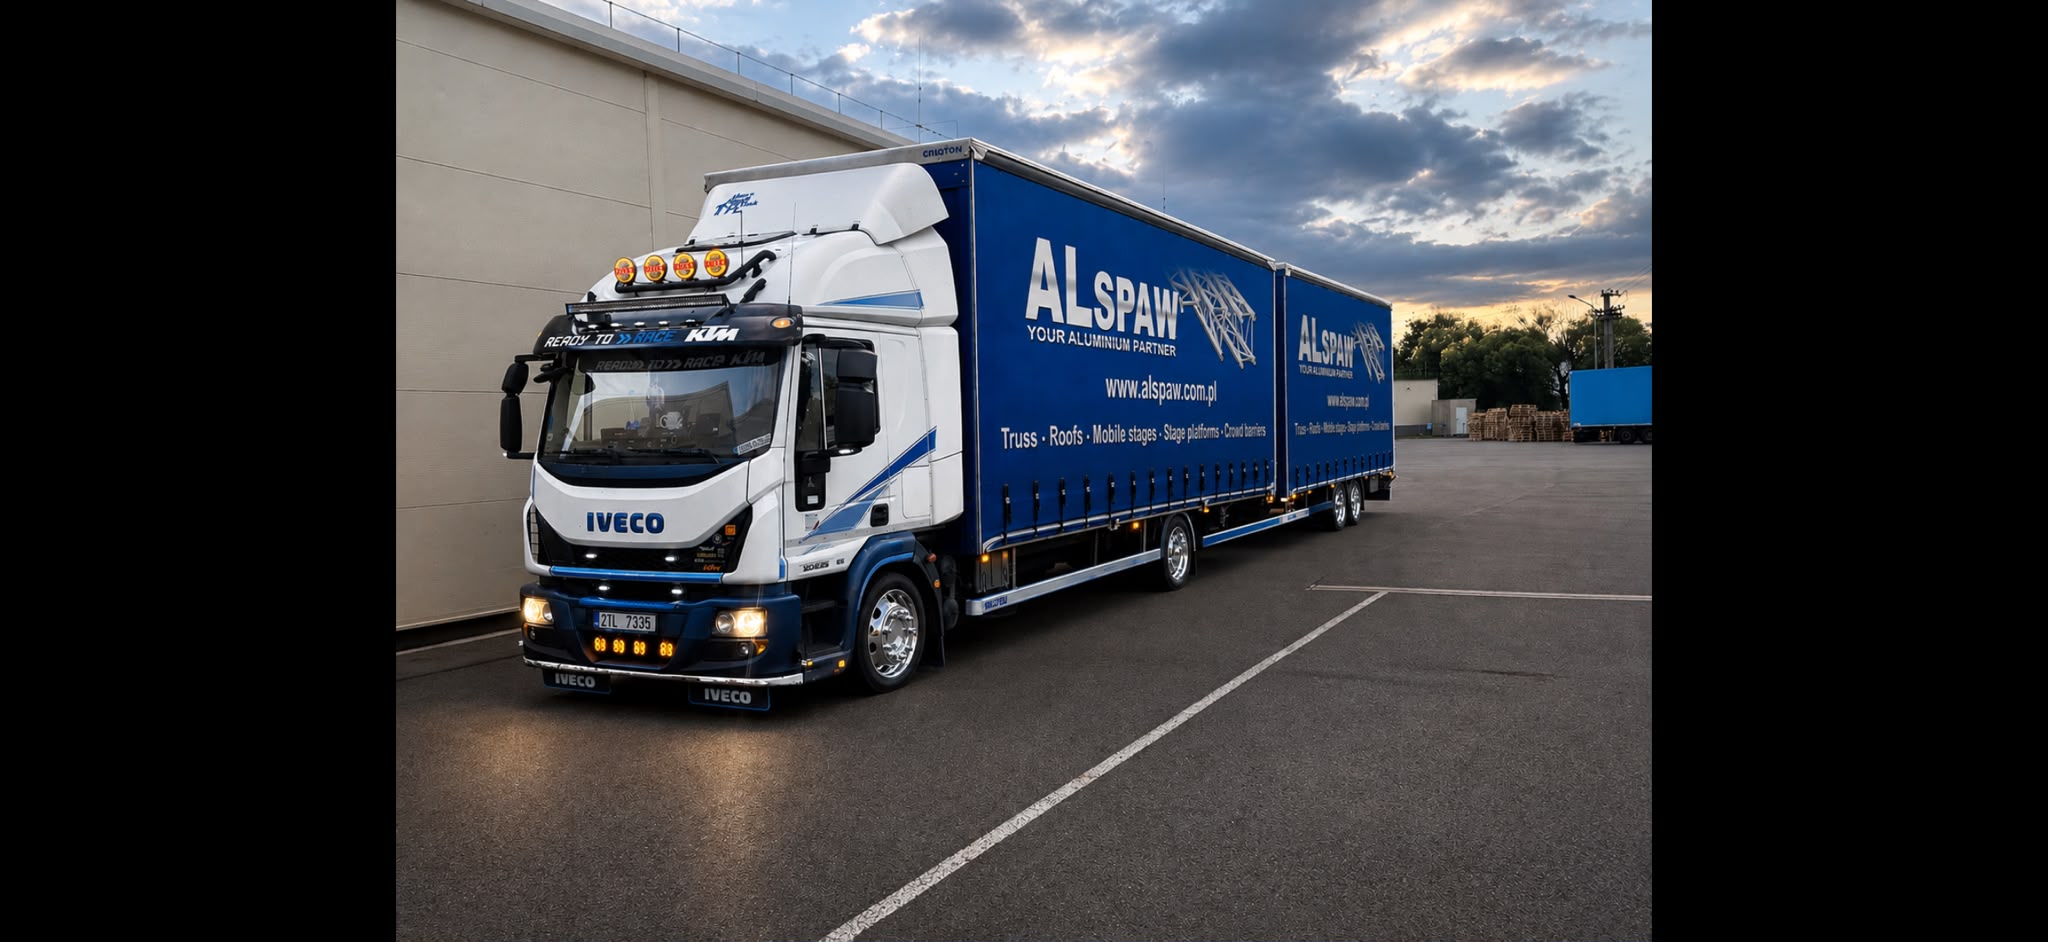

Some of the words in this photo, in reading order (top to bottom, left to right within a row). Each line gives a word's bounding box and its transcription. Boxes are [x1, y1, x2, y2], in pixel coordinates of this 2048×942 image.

[1025, 237, 1179, 340] ALSPAW
[544, 335, 588, 347] READY
[596, 334, 614, 344] TO
[633, 331, 675, 343] RACE
[684, 325, 739, 342] KTM
[1027, 325, 1065, 344] YOUR
[1068, 331, 1130, 351] ALUMINIUM
[1133, 340, 1176, 357] PARTNER
[1298, 314, 1354, 368] ALSPAW
[684, 355, 725, 368] RACE
[1105, 375, 1217, 407] www.alspaw.com.pl
[1001, 427, 1038, 449] Truss
[1050, 425, 1083, 446] Roofs
[1093, 424, 1125, 444] Mobile
[1129, 425, 1157, 446] stages
[1164, 424, 1185, 444] Stage
[1188, 423, 1220, 443] platforms
[1224, 423, 1243, 438] Crowd
[1245, 423, 1266, 438] barriers
[587, 512, 664, 534] IVECO
[601, 614, 618, 628] 2TL
[626, 615, 651, 630] 7335
[555, 673, 595, 688] IVECO
[704, 688, 751, 704] IVECO
